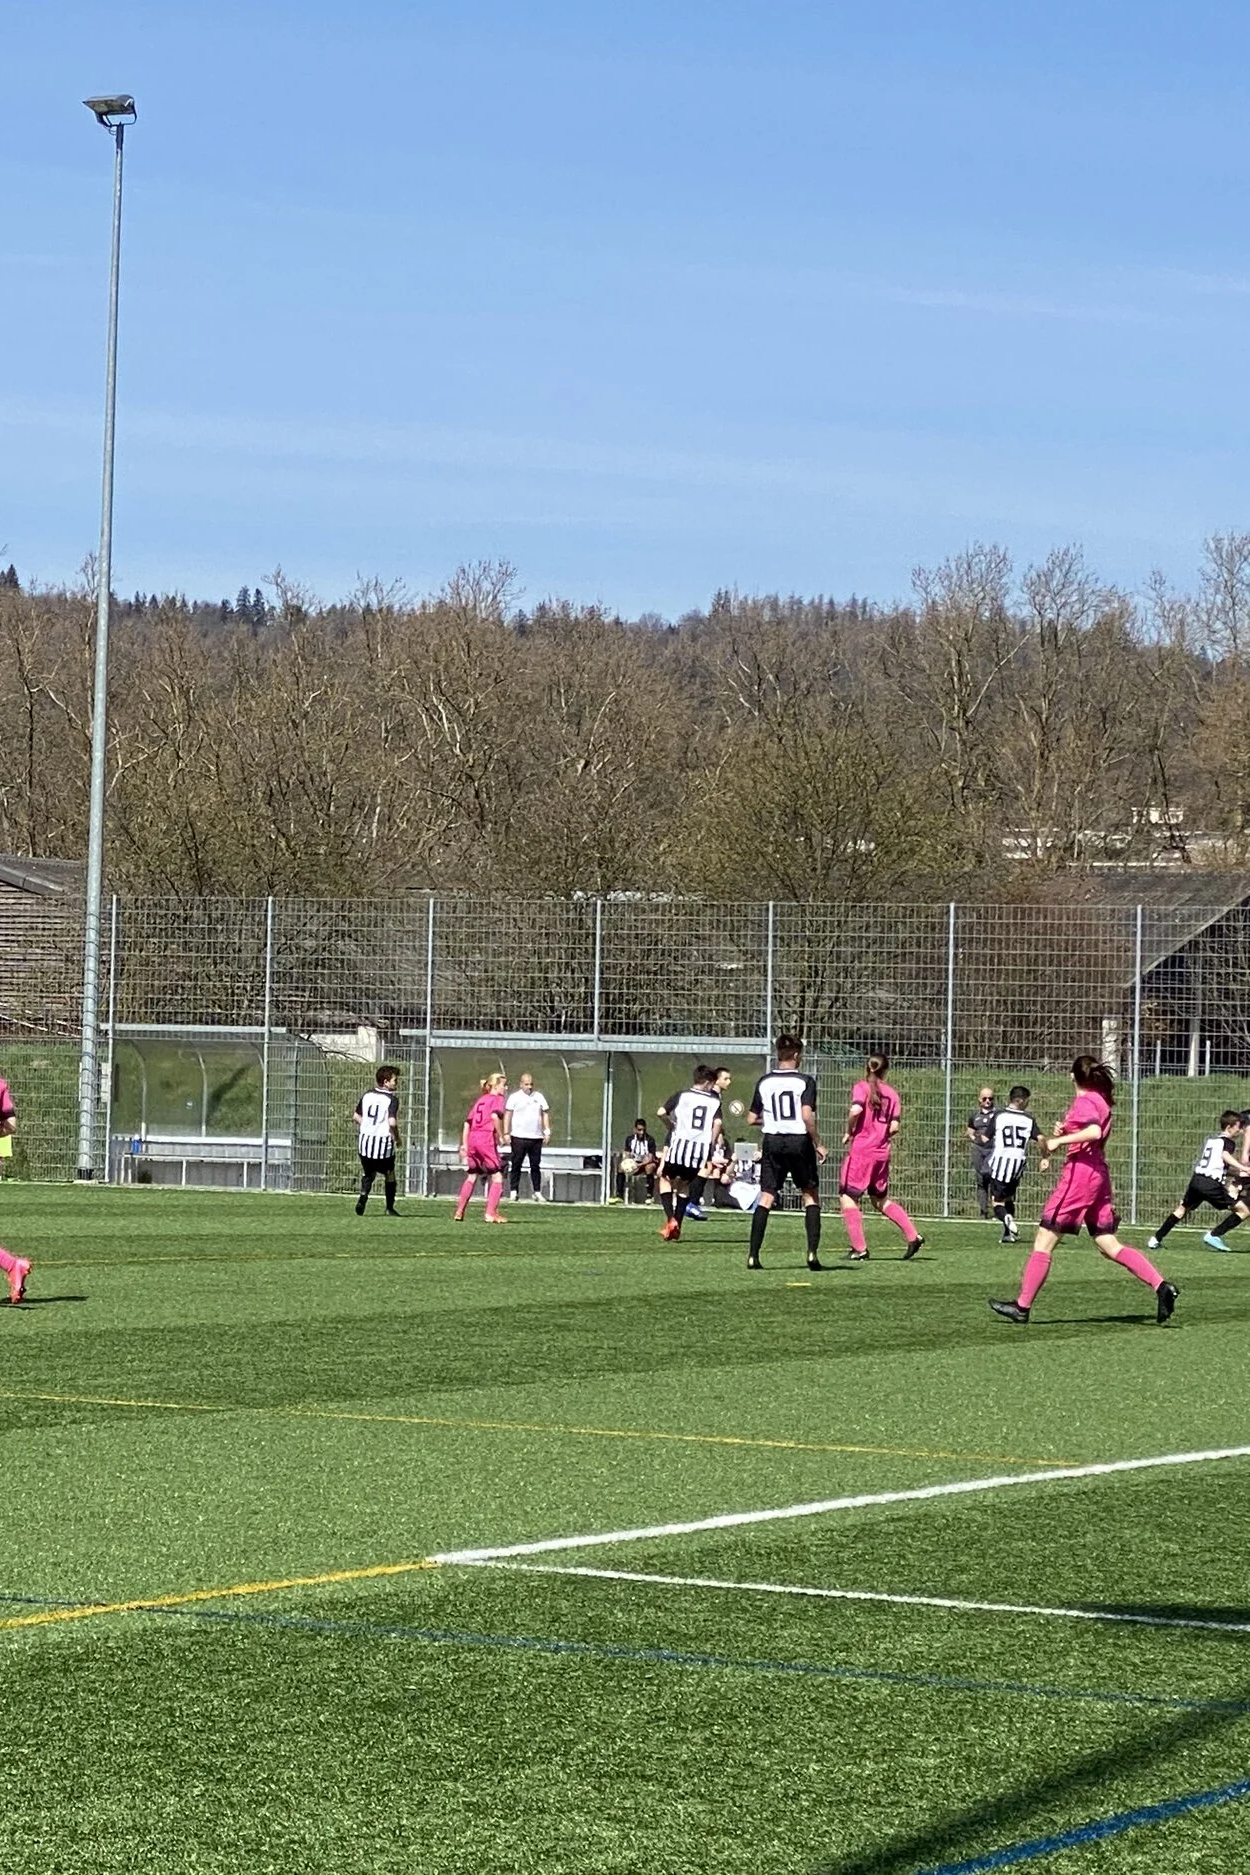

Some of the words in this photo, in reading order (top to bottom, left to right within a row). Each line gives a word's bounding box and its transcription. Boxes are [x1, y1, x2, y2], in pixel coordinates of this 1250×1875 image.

[367, 1104, 379, 1126] 4
[475, 1102, 486, 1124] 5
[691, 1105, 708, 1130] 8
[771, 1090, 797, 1122] 10
[1002, 1125, 1028, 1150] 85
